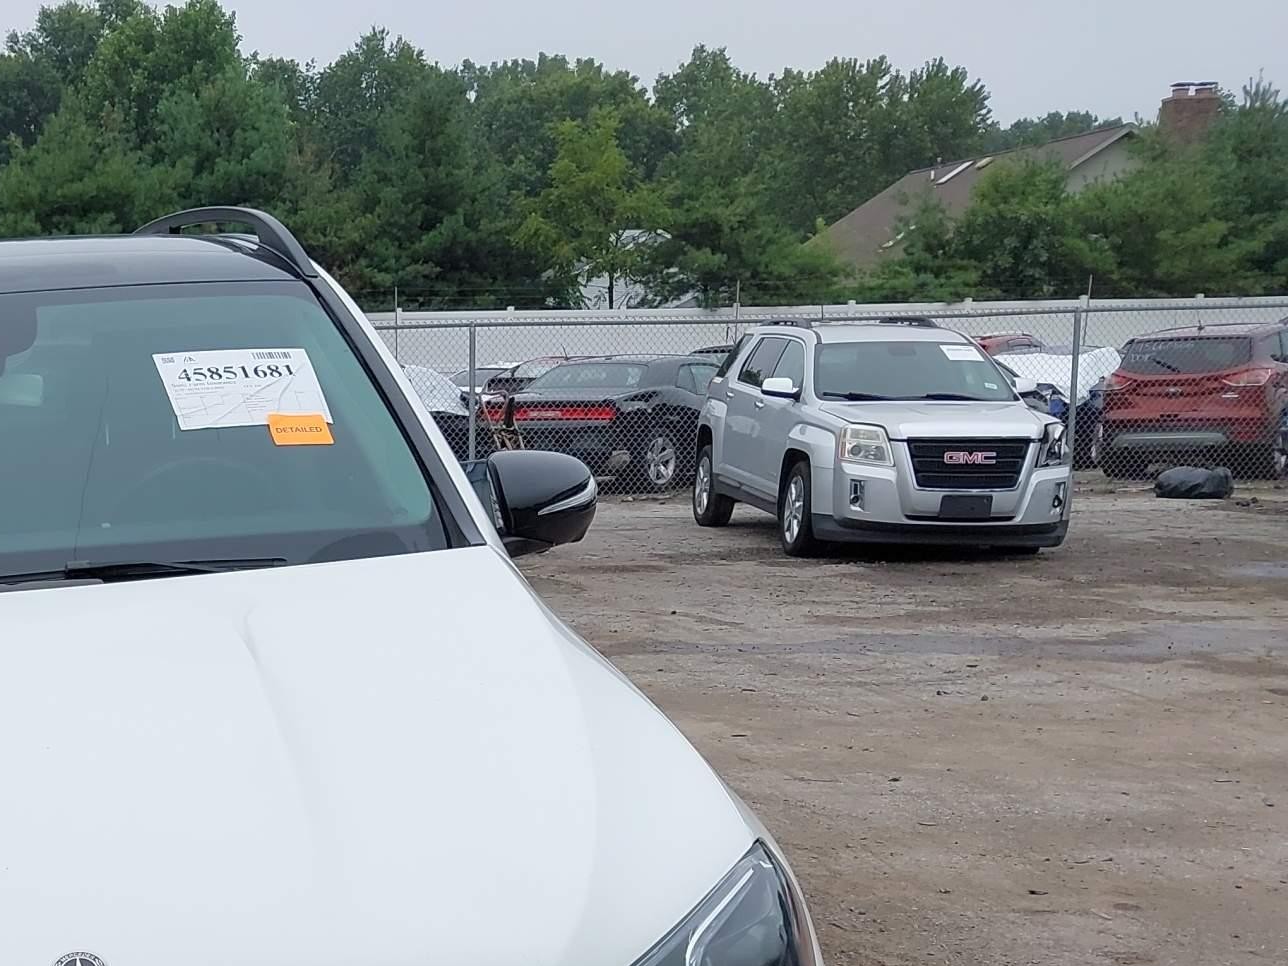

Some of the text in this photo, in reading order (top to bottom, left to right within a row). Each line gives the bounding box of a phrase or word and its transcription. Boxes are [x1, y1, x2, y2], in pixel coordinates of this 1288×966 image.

[177, 363, 296, 382] 45851681
[275, 425, 323, 434] DETAILED
[943, 451, 997, 464] GMC
